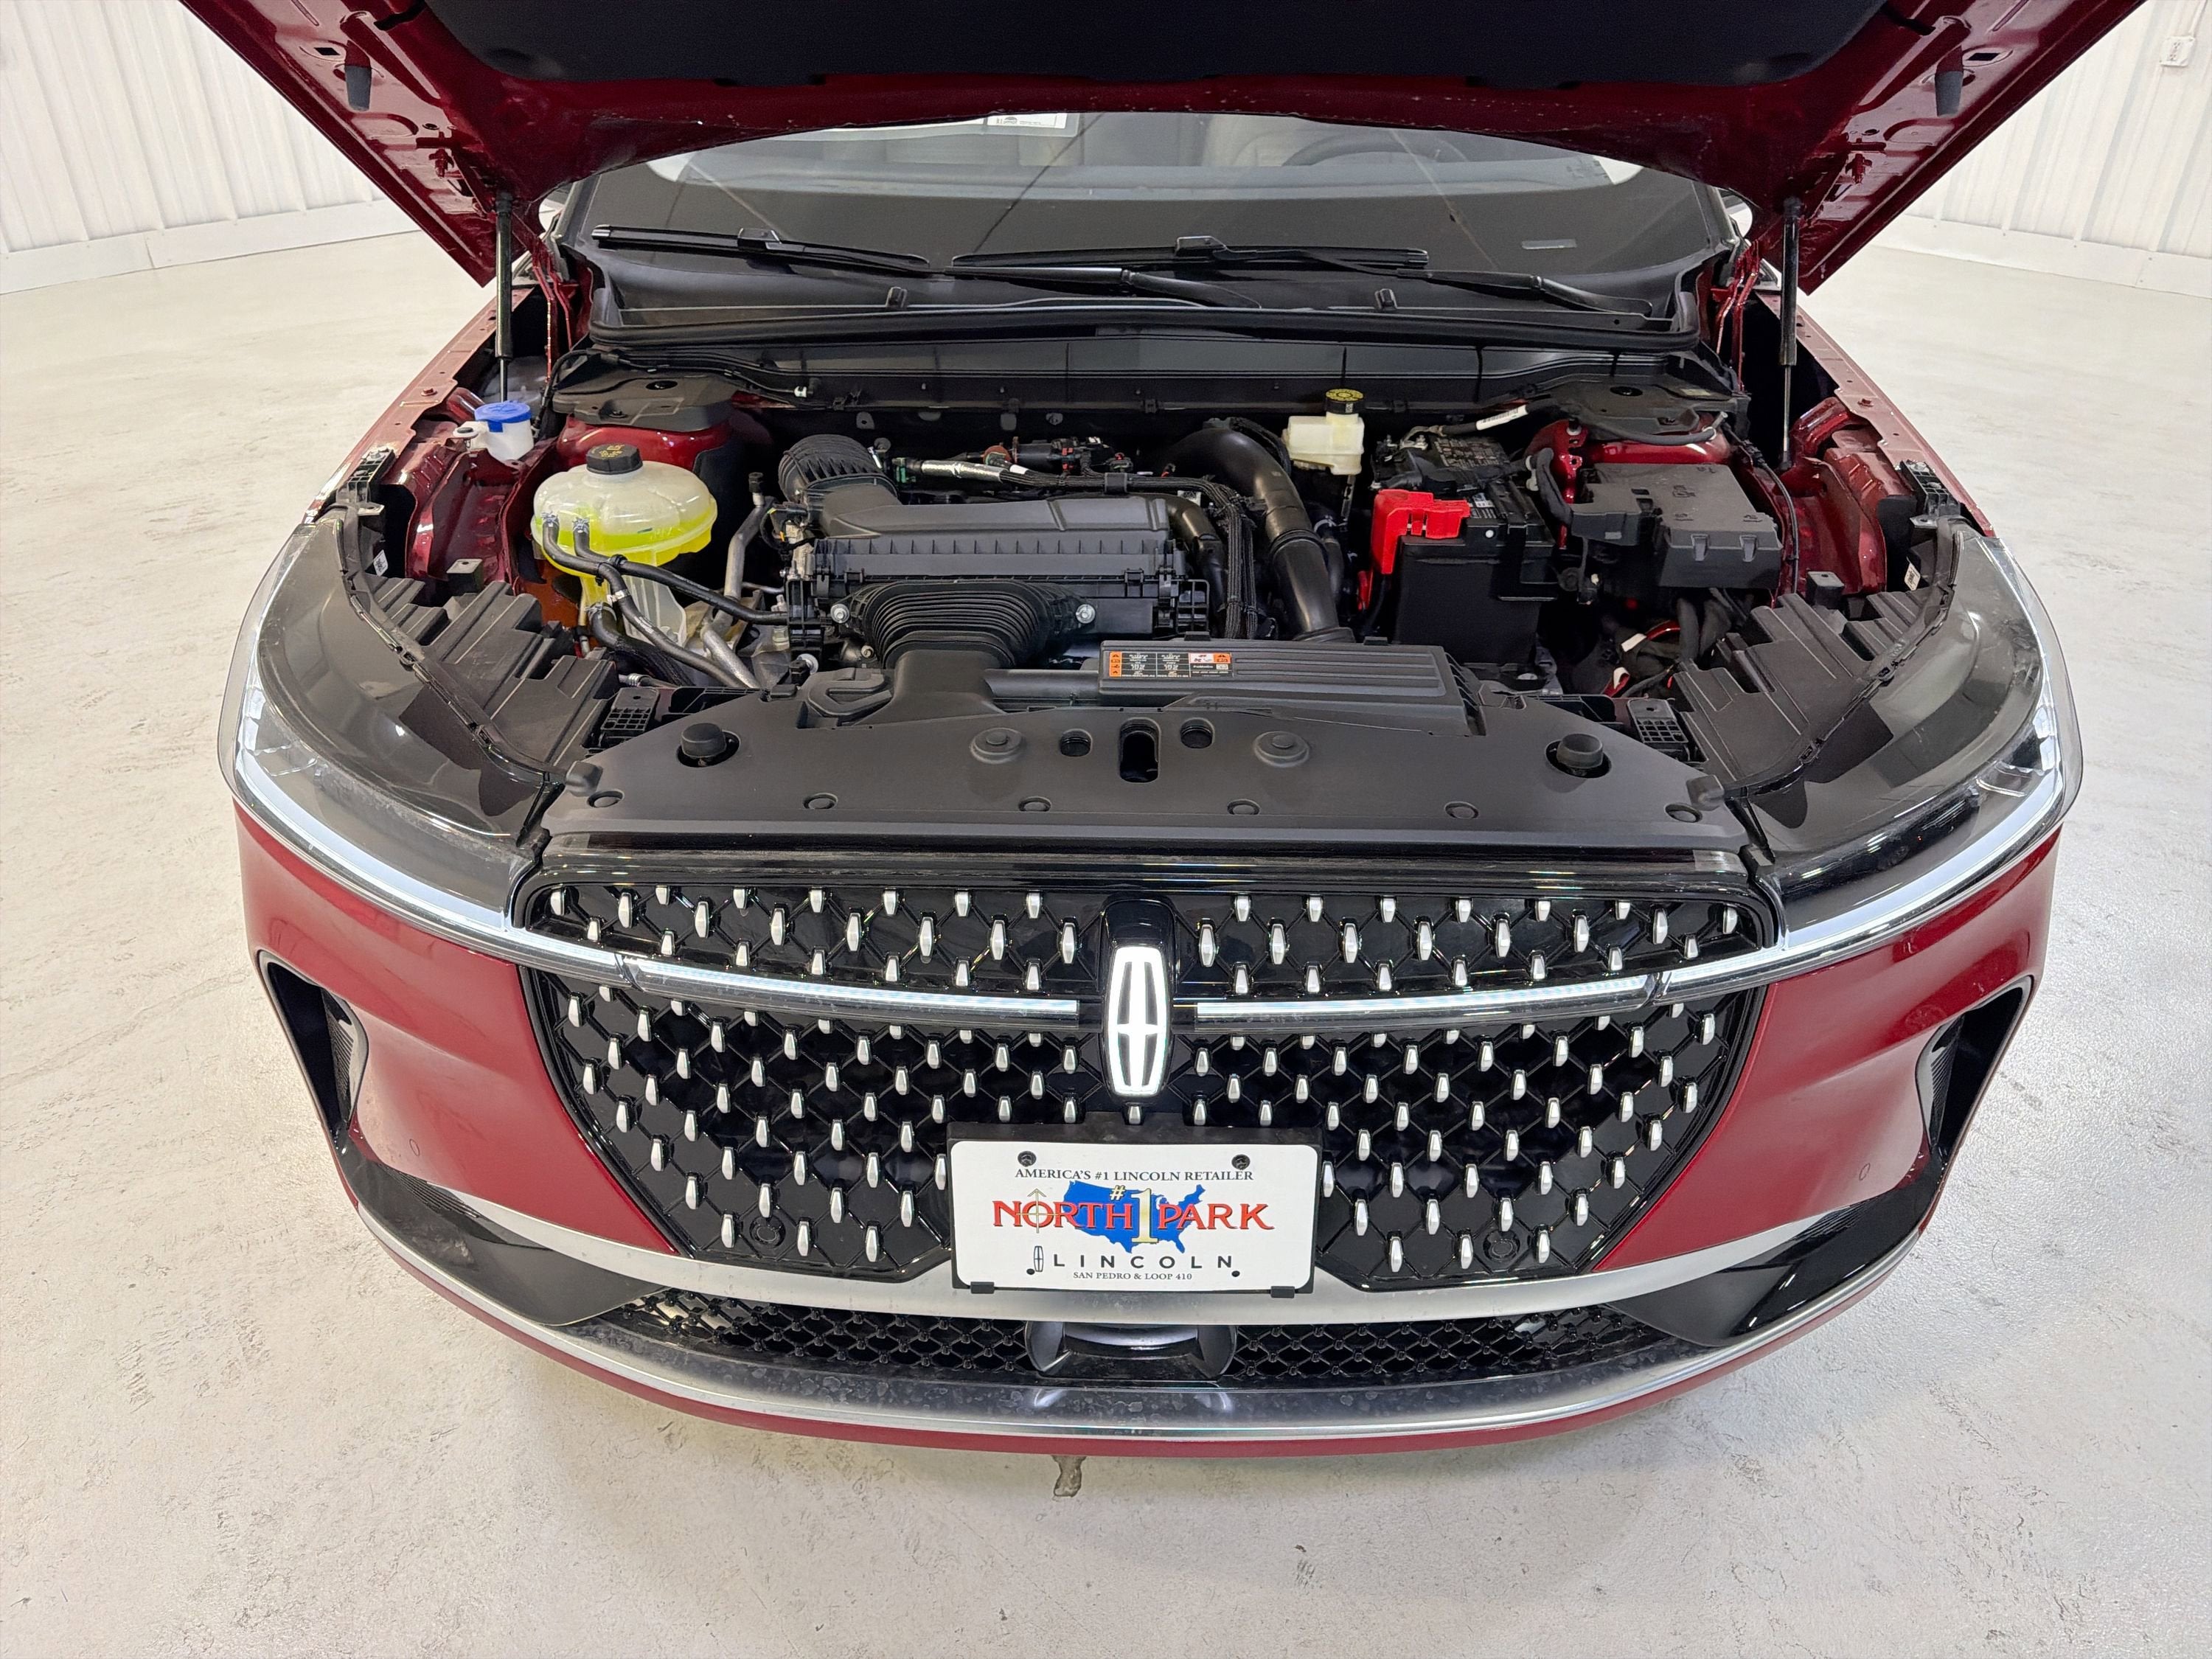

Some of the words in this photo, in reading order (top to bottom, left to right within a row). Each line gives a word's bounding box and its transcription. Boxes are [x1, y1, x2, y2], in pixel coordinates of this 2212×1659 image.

[1015, 1169, 1091, 1180] AMERICA'S
[1095, 1172, 1109, 1180] #1
[1114, 1172, 1180, 1181] LINCOLN
[1184, 1172, 1254, 1180] RETAILER
[992, 1200, 1133, 1230] NORTH
[1158, 1203, 1275, 1230] PARK
[1053, 1253, 1232, 1269] LINCOLN
